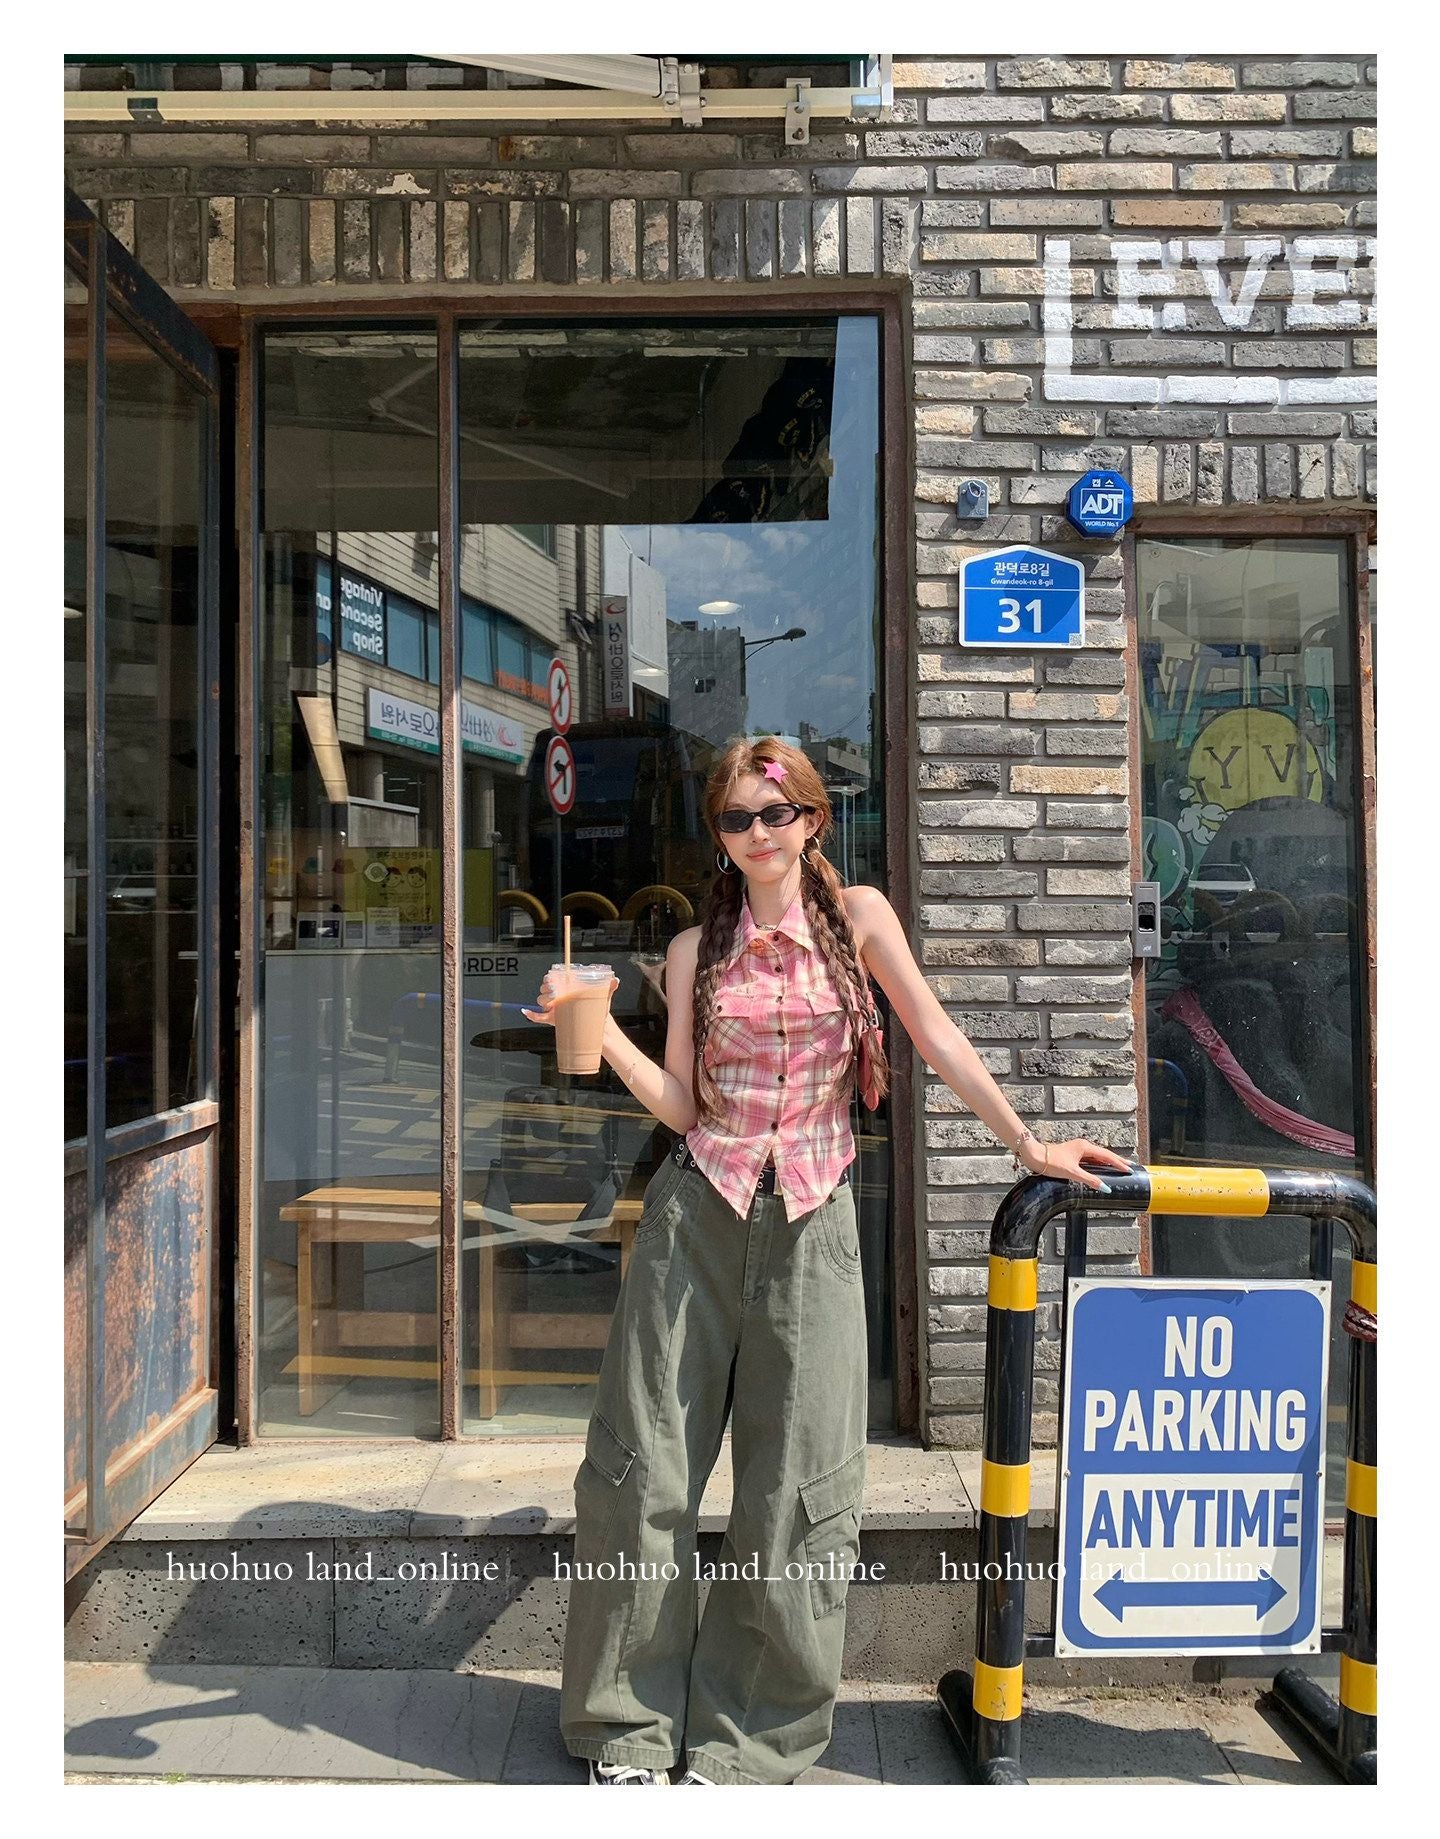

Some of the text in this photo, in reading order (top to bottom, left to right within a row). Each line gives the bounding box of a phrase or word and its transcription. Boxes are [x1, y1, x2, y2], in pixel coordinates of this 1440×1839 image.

[1043, 238, 1377, 402] LEVE
[1081, 493, 1124, 515] ADT
[1107, 520, 1119, 528] No.1
[990, 577, 1054, 587] Gwandeok-ro 8-gil
[993, 562, 1050, 577] 관덕로8길
[997, 598, 1042, 634] 31
[463, 957, 519, 973] RDER
[1163, 1316, 1234, 1378] NO
[1083, 1389, 1307, 1452] PARKING
[1084, 1489, 1300, 1549] ANYTIME
